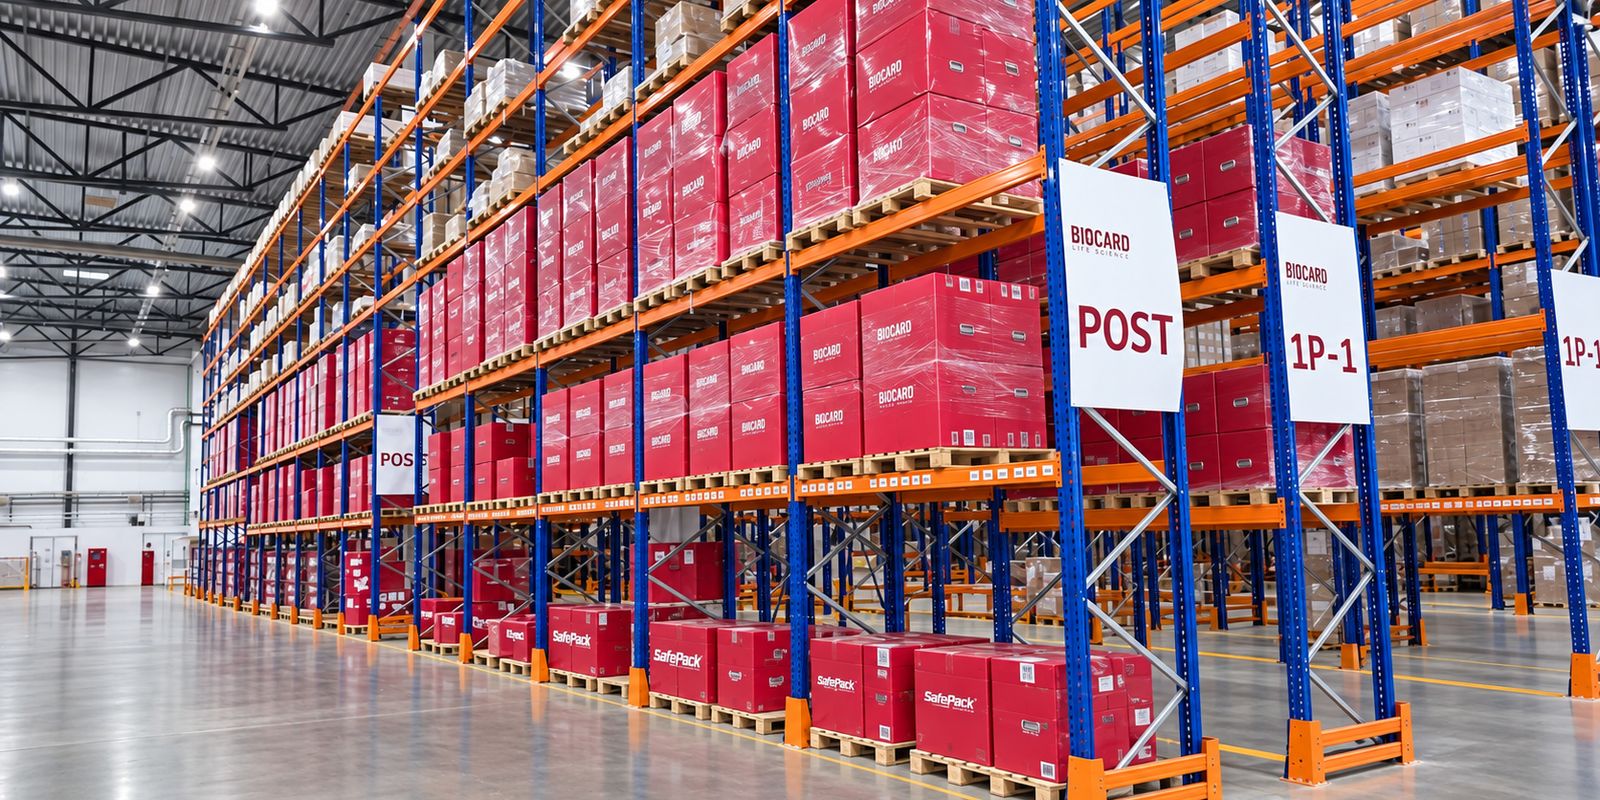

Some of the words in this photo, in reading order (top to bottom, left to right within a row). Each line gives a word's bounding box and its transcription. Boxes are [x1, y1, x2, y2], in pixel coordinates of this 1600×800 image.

[868, 59, 902, 89] BIOCARD
[1071, 225, 1130, 252] BIOCARD
[1072, 245, 1090, 253] LIFE
[1095, 249, 1129, 260] SCIENCE
[1285, 261, 1328, 284] BIOCARD
[877, 320, 912, 341] BIOCARD
[1078, 305, 1173, 355] POST
[813, 343, 841, 361] BIOCARD
[1290, 333, 1358, 374] 1P-1
[1563, 335, 1600, 369] 1P-1
[878, 385, 914, 404] BIOCARD
[815, 410, 843, 425] BIOCARD
[553, 630, 591, 646] SafePack
[653, 649, 703, 668] SafePack
[817, 675, 855, 691] SafePack
[924, 690, 975, 710] SafePack
